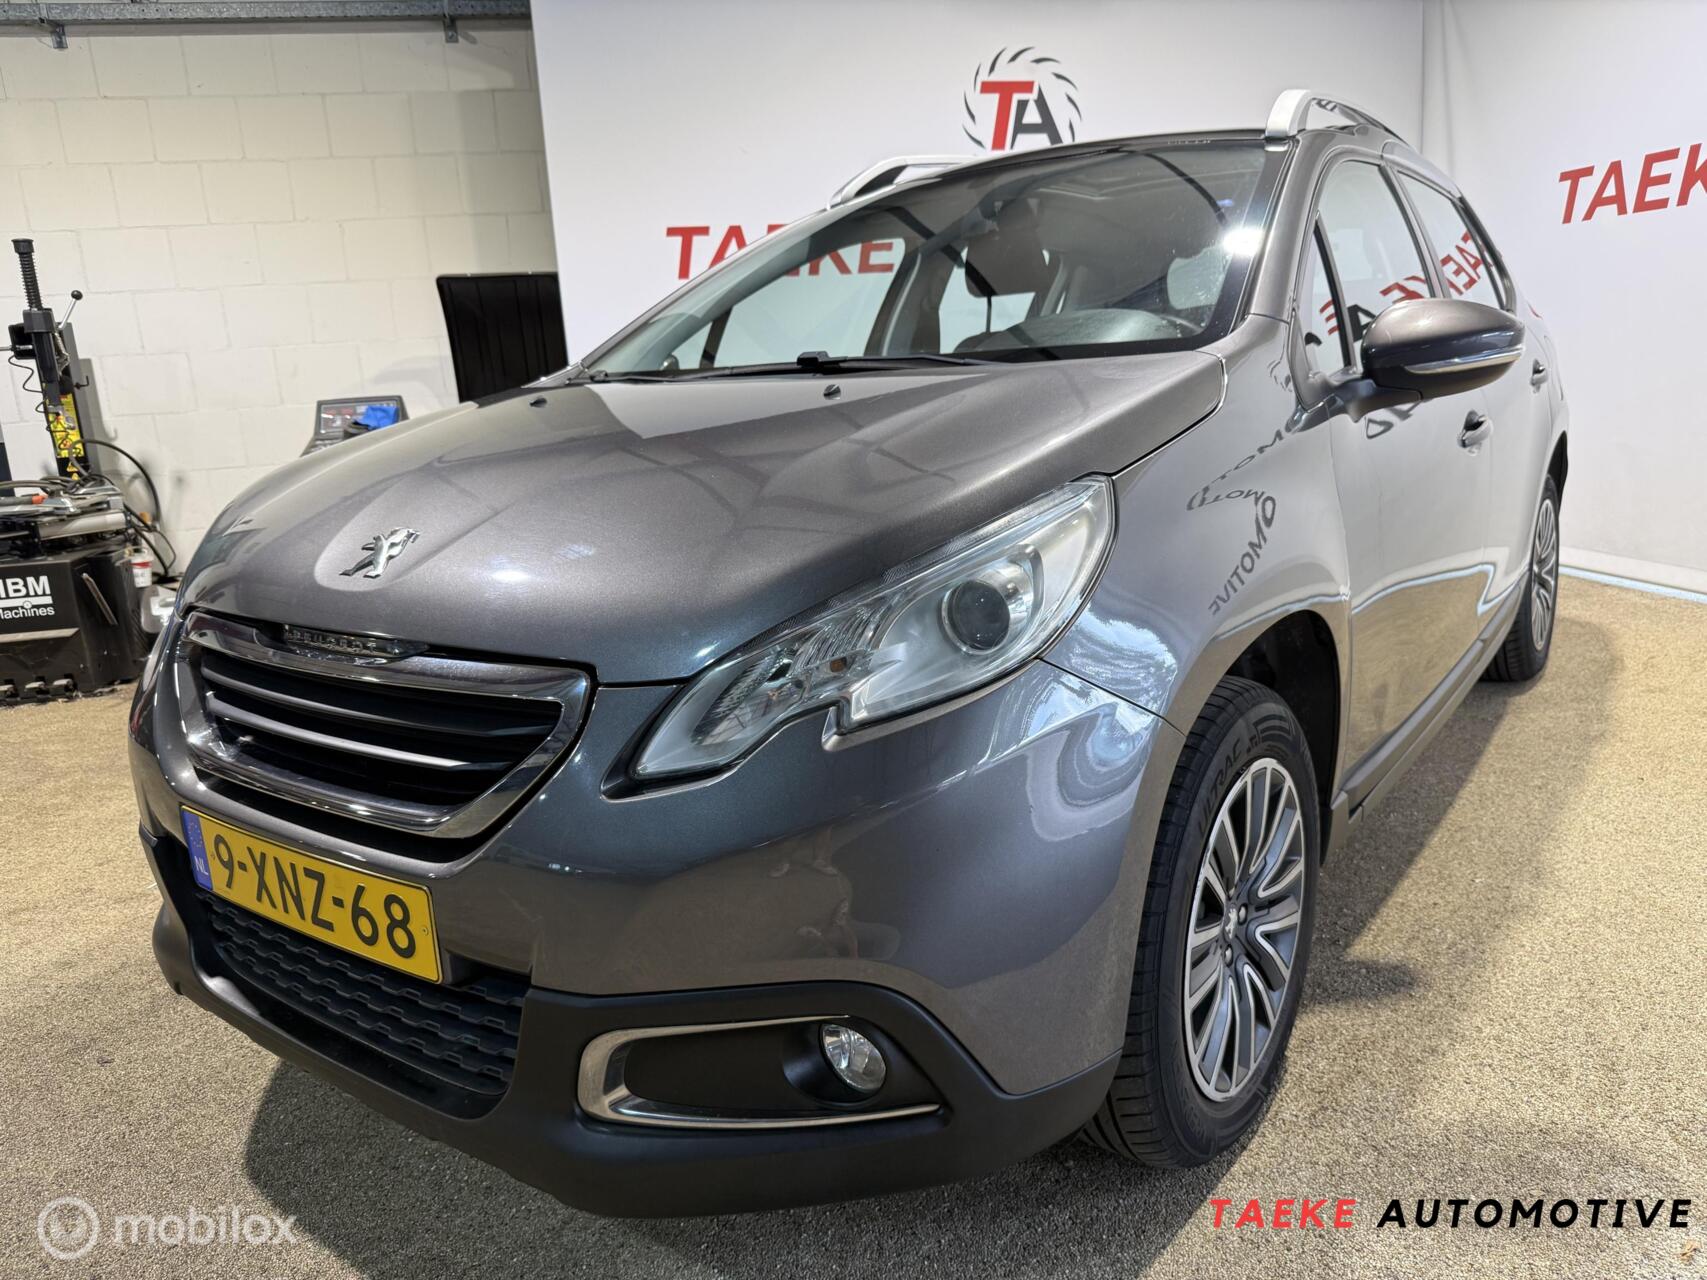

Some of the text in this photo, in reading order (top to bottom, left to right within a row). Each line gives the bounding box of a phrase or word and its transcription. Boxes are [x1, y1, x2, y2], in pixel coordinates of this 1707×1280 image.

[980, 81, 1064, 151] TA
[666, 223, 895, 280] TAKE
[195, 855, 210, 876] NL
[213, 833, 416, 959] 9-XNZ-68
